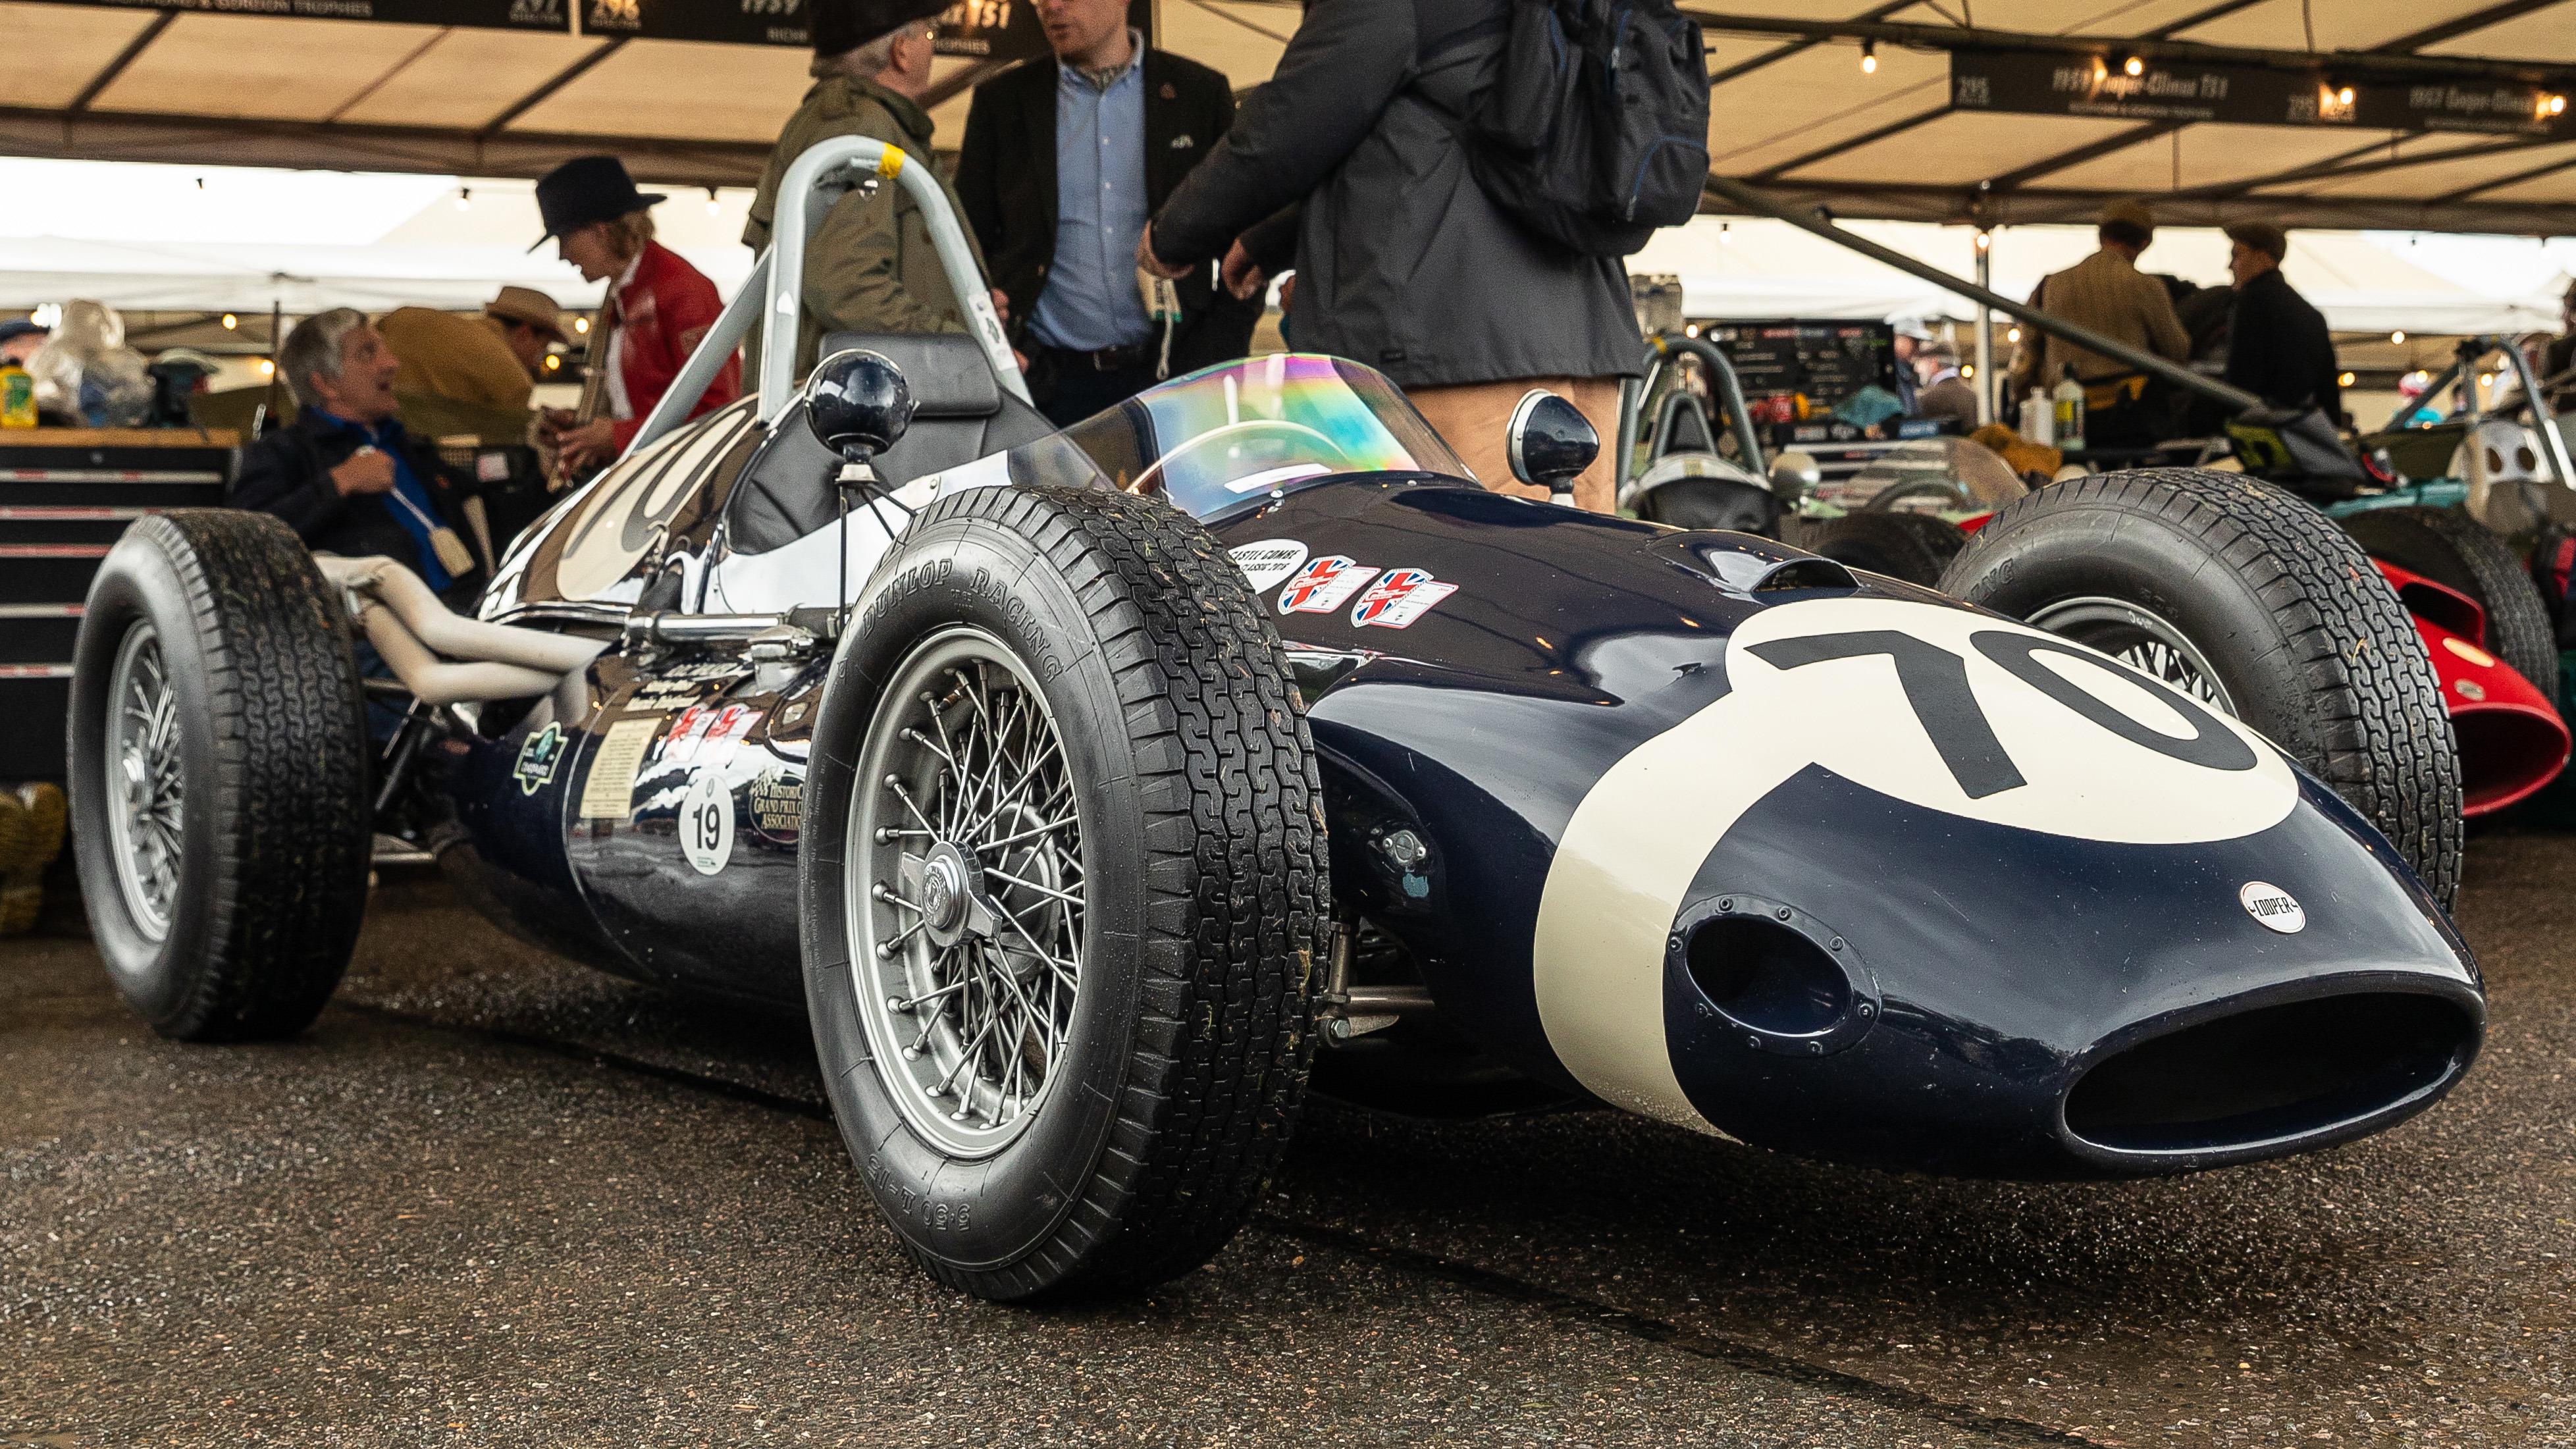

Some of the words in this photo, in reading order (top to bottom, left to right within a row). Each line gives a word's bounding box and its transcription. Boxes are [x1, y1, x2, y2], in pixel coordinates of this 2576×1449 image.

[863, 558, 953, 640] DUNLOP
[970, 567, 1065, 684] RACING
[1743, 629, 2257, 799] 70
[770, 782, 803, 800] HISTORIC
[754, 797, 779, 814] GRAND
[693, 803, 721, 851] 19
[761, 813, 801, 830] ASSOCIATI
[2253, 897, 2294, 916] COOPER
